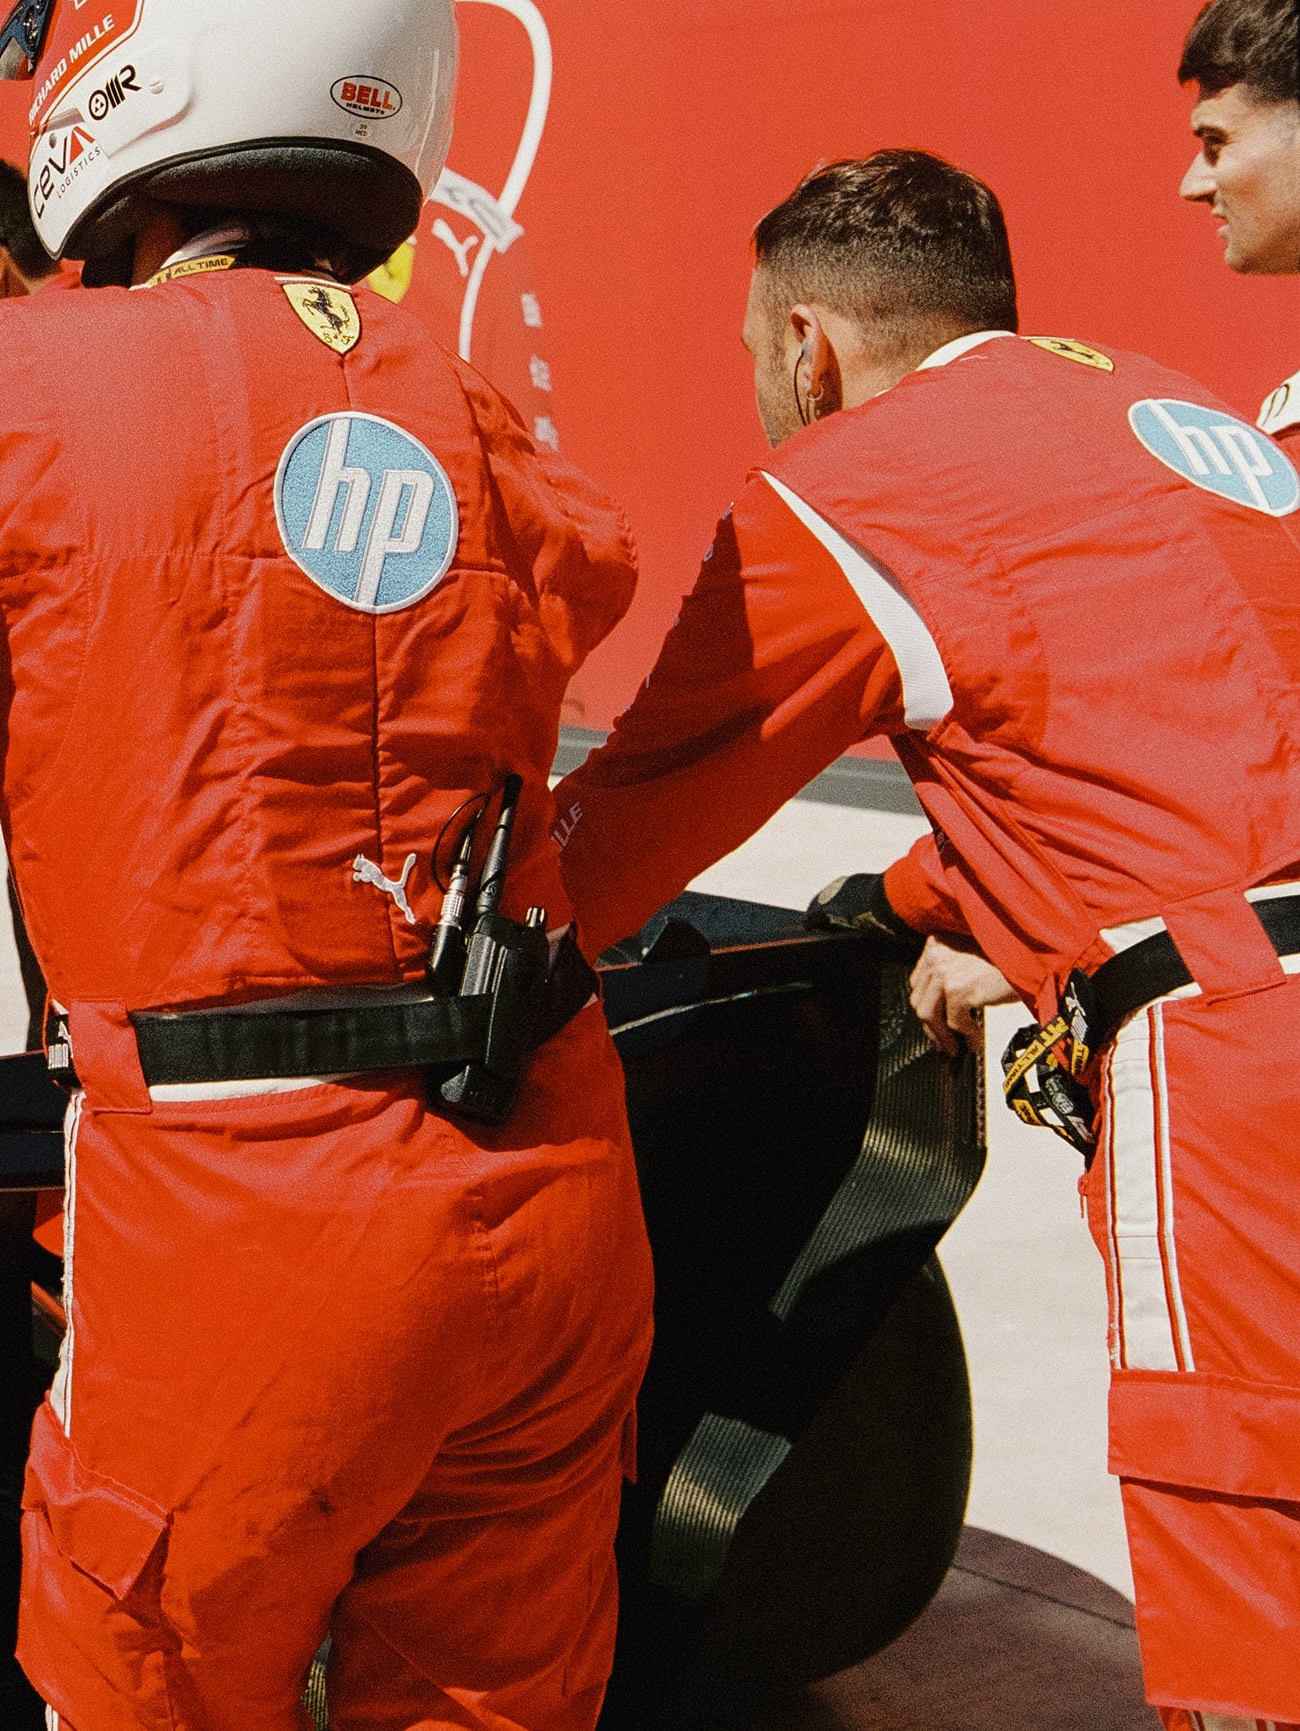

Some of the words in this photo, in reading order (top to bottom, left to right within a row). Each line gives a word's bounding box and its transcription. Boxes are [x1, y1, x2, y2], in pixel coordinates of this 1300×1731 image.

[28, 58, 68, 126] RICHARD
[68, 14, 115, 63] MILLE
[340, 81, 393, 110] BELL
[56, 146, 101, 199] LOGISTICS
[174, 264, 197, 275] ALL
[196, 257, 229, 270] TIME
[1144, 399, 1276, 510] hp
[300, 417, 436, 607] hp
